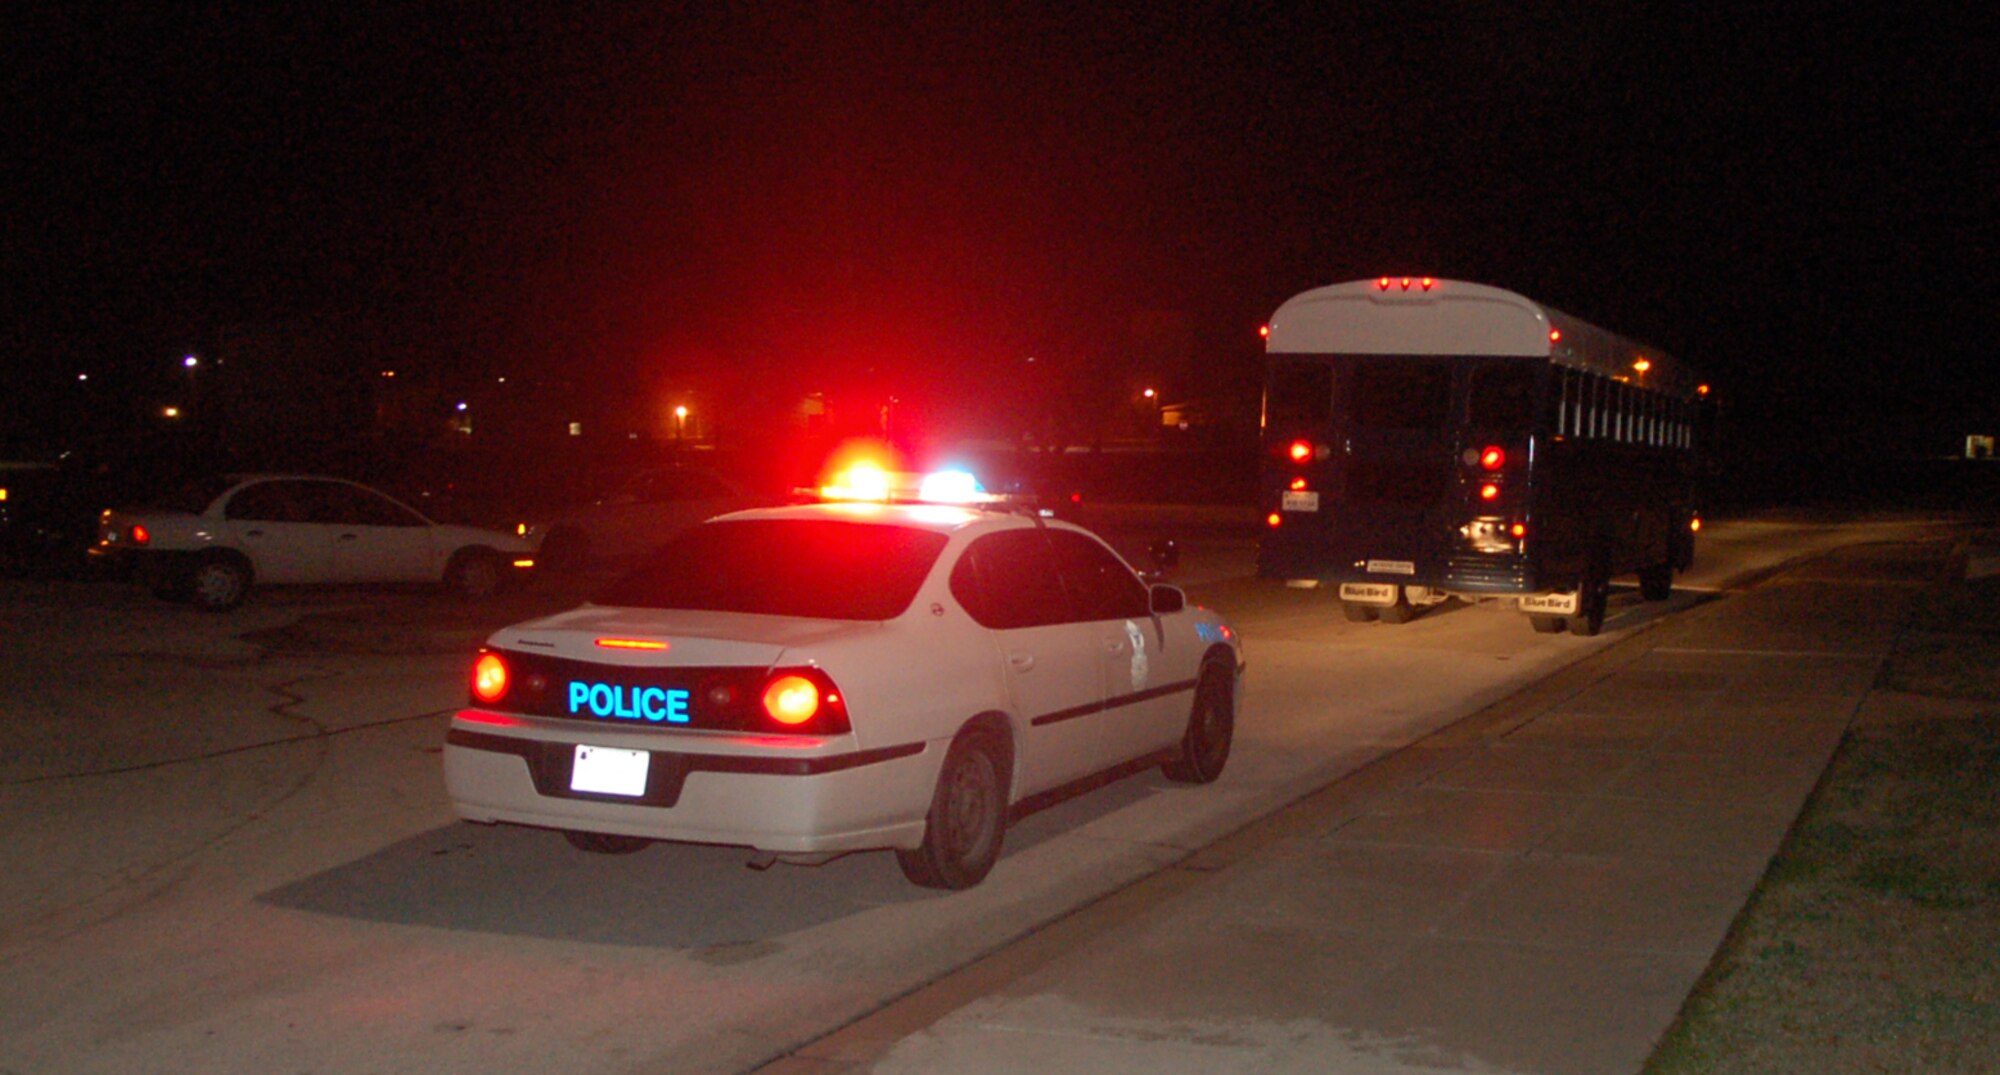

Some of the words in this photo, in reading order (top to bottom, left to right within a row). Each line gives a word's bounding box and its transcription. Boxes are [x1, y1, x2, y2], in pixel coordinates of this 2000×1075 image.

[1366, 588, 1389, 598] Bird
[1547, 599, 1571, 609] Bird
[568, 681, 691, 724] POLICE
